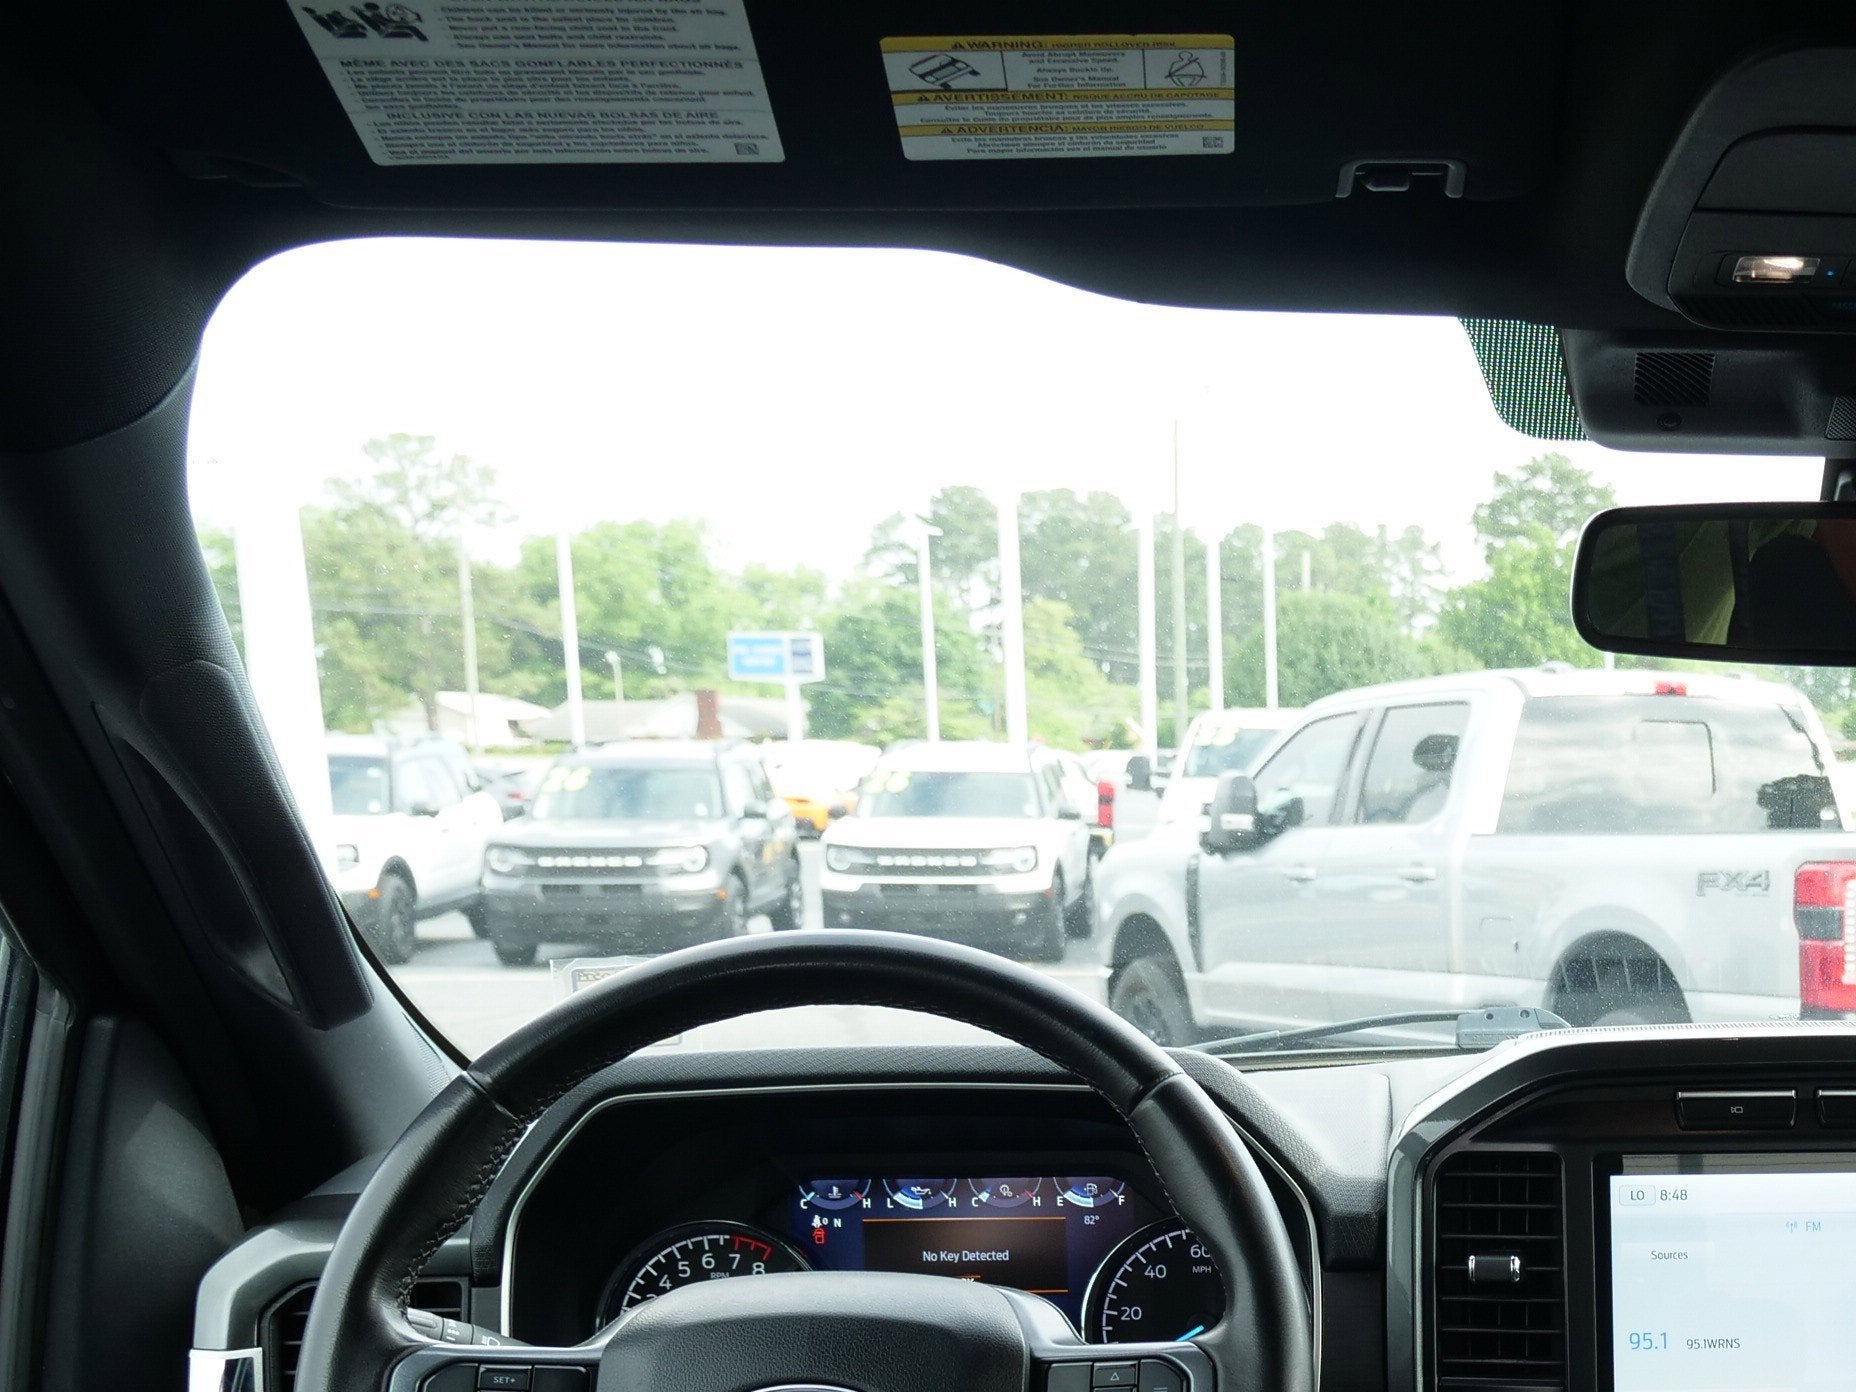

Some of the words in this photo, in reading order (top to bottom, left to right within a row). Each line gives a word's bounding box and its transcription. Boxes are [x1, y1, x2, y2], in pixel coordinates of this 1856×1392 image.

[1696, 870, 1770, 897] FX4
[1118, 1195, 1126, 1205] F
[1630, 1190, 1645, 1201] LO
[1659, 1189, 1688, 1201] 8:48
[800, 1199, 808, 1209] C
[862, 1198, 872, 1209] H
[887, 1198, 894, 1209] L
[948, 1198, 957, 1208] H
[971, 1197, 979, 1207] C
[1033, 1196, 1041, 1207] H
[1056, 1196, 1064, 1207] E
[833, 1217, 842, 1228] N
[1805, 1221, 1822, 1232] FM
[922, 1250, 937, 1261] No
[939, 1250, 960, 1263] Key
[962, 1249, 1010, 1261] Detected
[1651, 1249, 1688, 1260] Sources
[701, 1253, 715, 1269] 6
[729, 1254, 741, 1269] 7
[678, 1261, 691, 1277] 5
[752, 1261, 766, 1275] 8
[1144, 1264, 1167, 1278] 40
[1192, 1265, 1212, 1273] MPH
[710, 1271, 730, 1279] RPM
[659, 1274, 673, 1290] 4
[1120, 1306, 1142, 1320] 20
[1628, 1332, 1668, 1351] 95.1
[1686, 1338, 1741, 1350] 95.1WRNS
